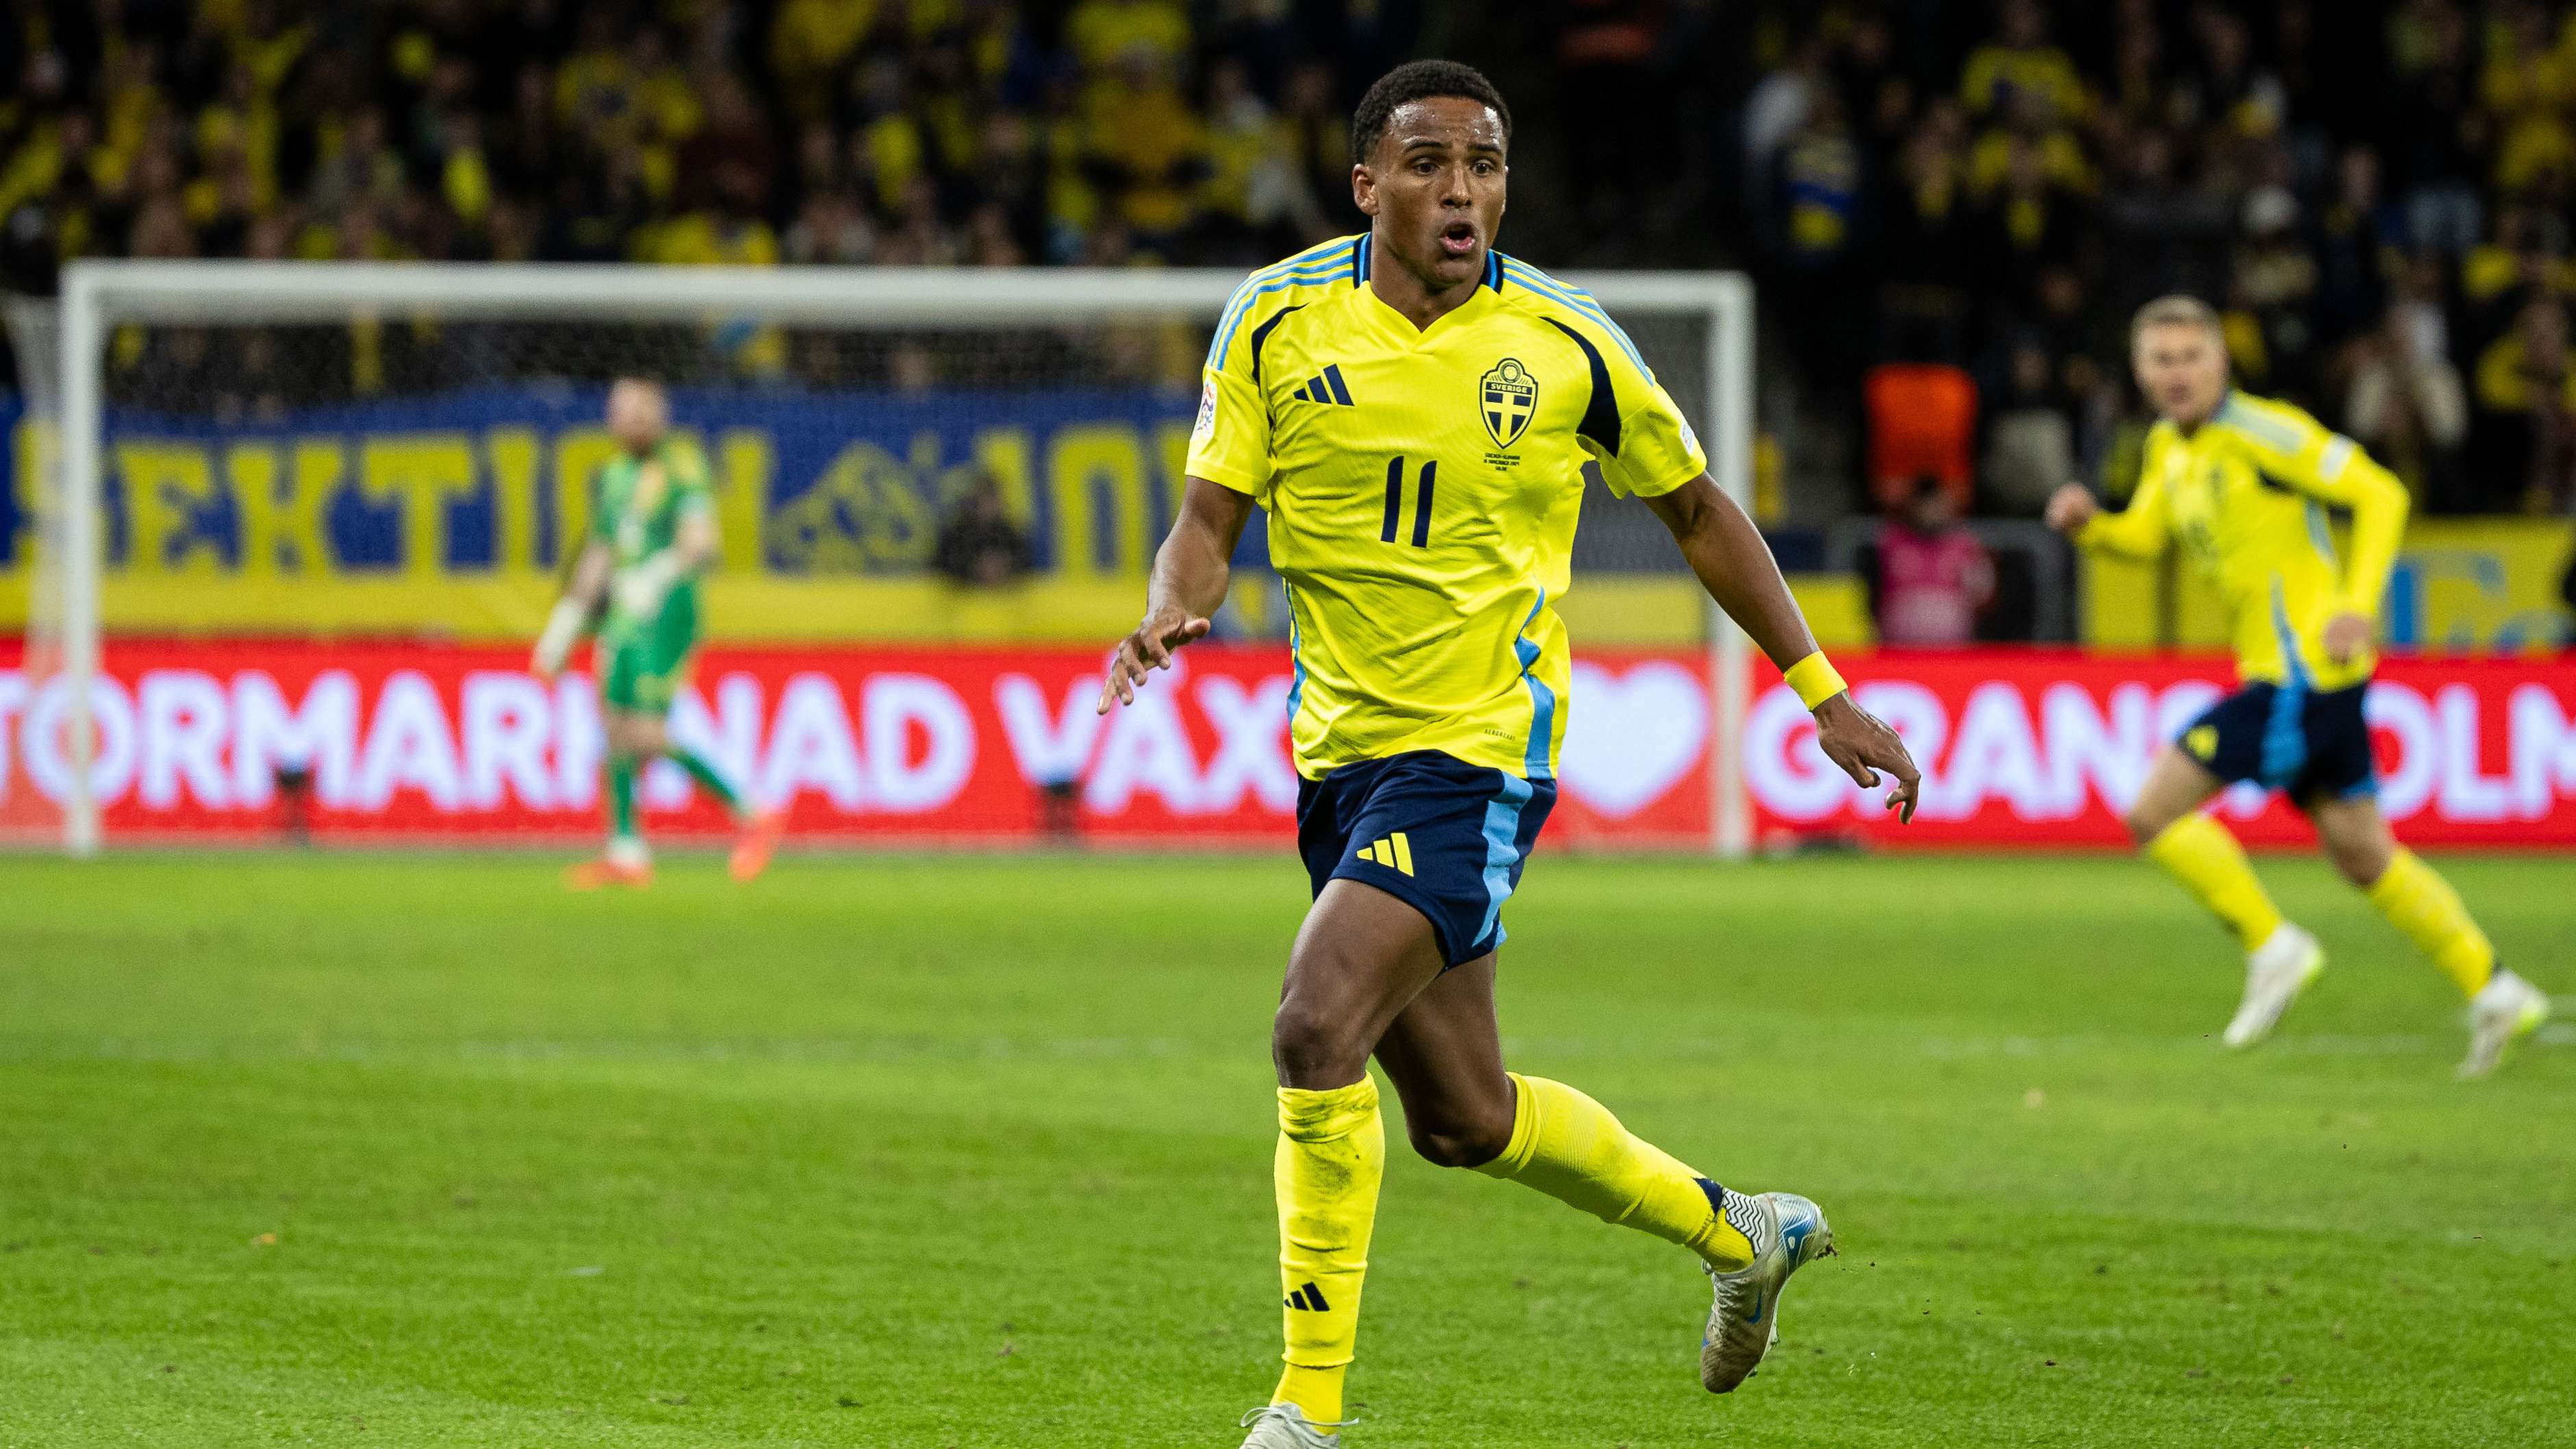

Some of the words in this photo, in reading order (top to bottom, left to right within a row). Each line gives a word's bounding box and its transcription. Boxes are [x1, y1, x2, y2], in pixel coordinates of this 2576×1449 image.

[1491, 383, 1528, 393] SVERIGE
[1380, 455, 1437, 548] 11
[1747, 681, 2576, 821] GRANOLM
